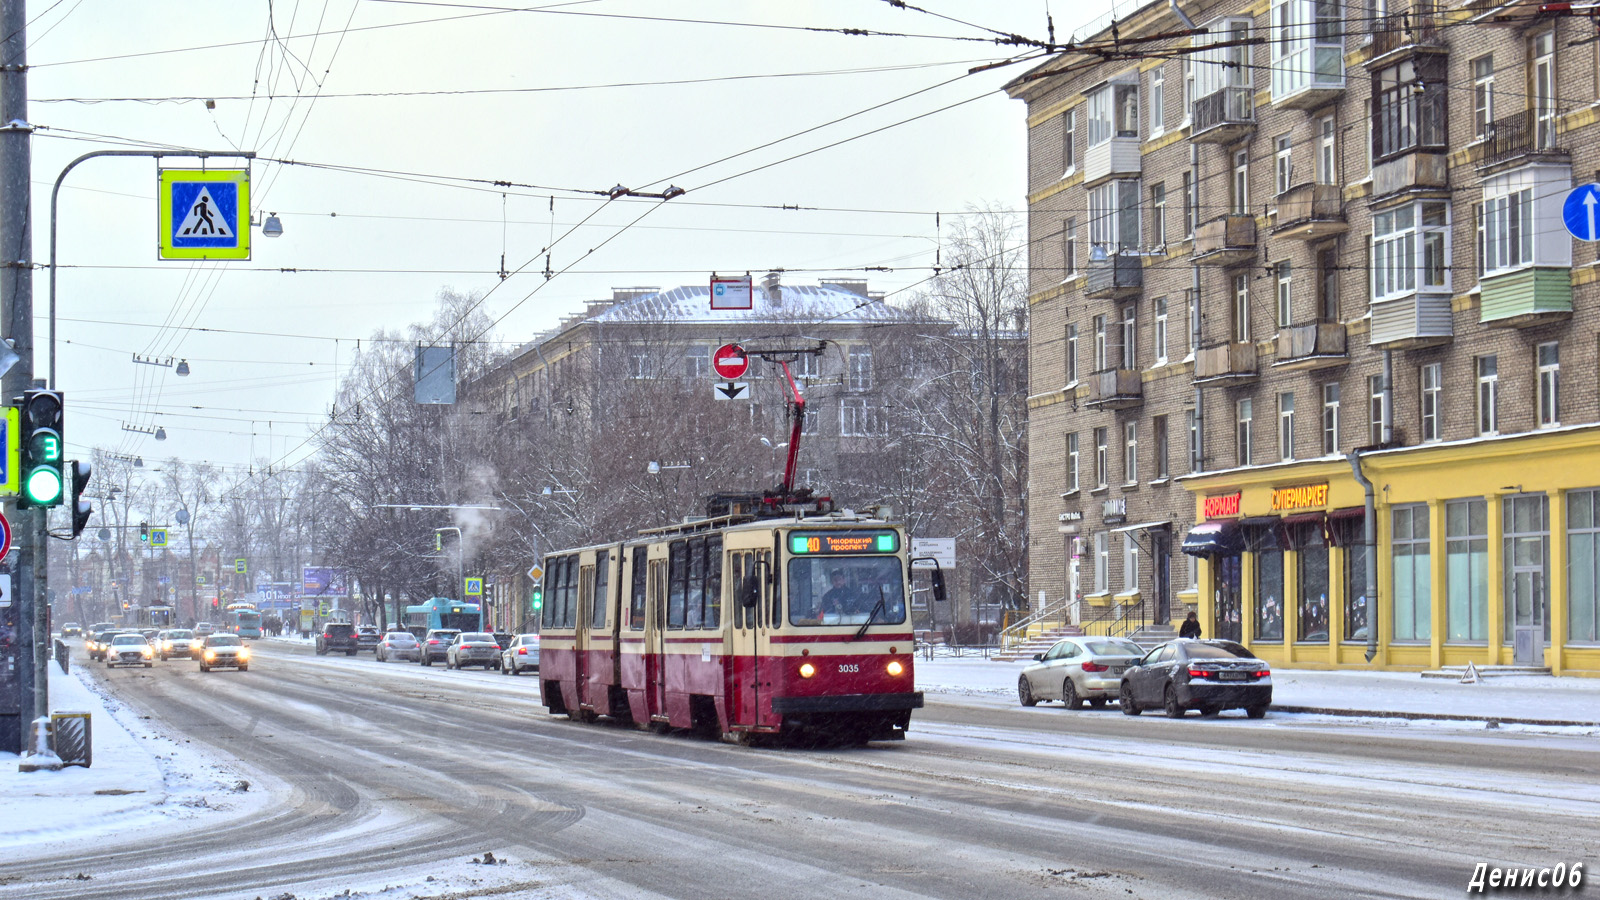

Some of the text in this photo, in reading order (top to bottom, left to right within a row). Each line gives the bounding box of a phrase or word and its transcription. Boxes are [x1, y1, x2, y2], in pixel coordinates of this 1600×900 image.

[45, 438, 57, 459] 3
[1204, 494, 1239, 516] НОРМАН
[1271, 484, 1328, 510] СУПЕРМАРКЕТ
[807, 537, 820, 552] 40
[826, 536, 873, 545] Тихорецкий
[838, 664, 859, 673] 3035
